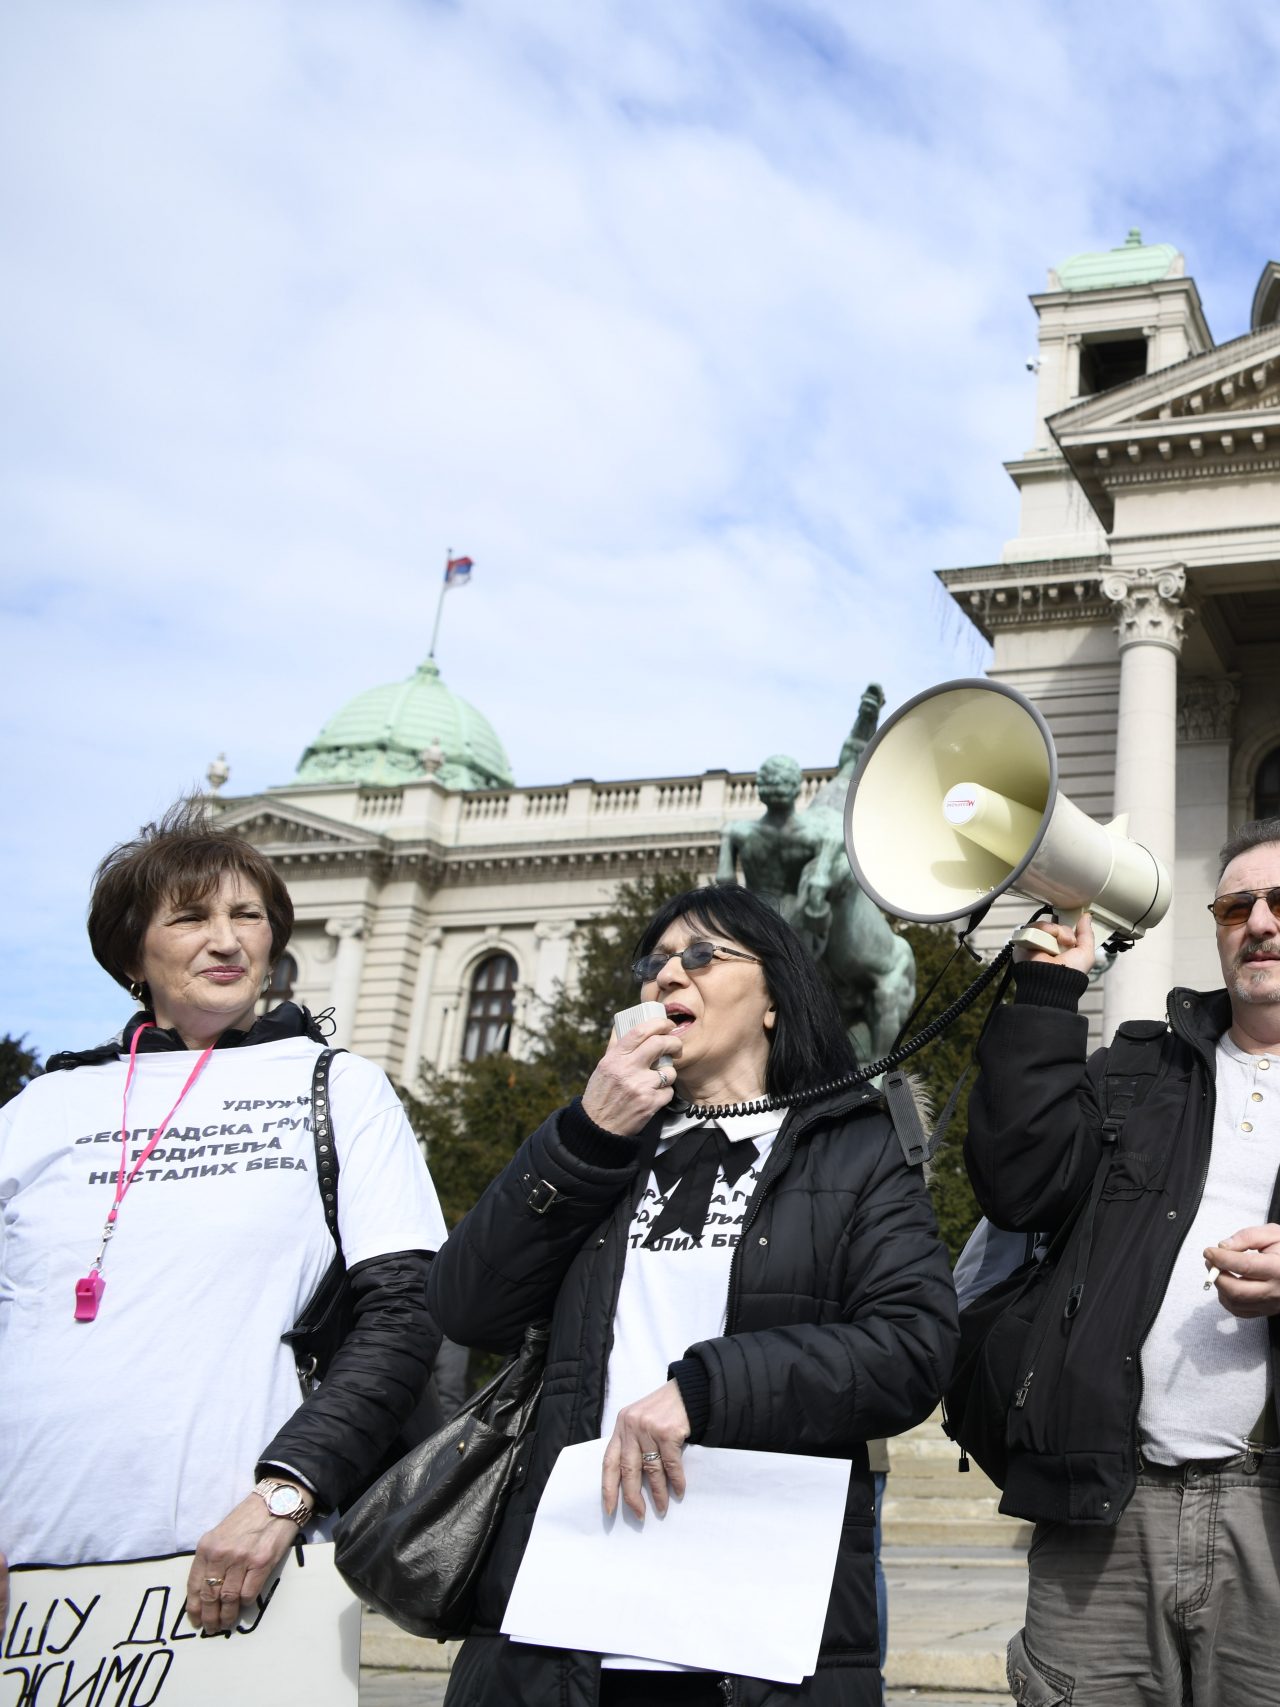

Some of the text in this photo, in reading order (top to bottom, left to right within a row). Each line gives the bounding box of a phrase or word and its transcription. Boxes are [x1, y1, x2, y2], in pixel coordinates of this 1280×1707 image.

[130, 1137, 282, 1162] РОДИТЕЉА
[88, 1157, 308, 1185] НЕСТАЛИХ БЕБА
